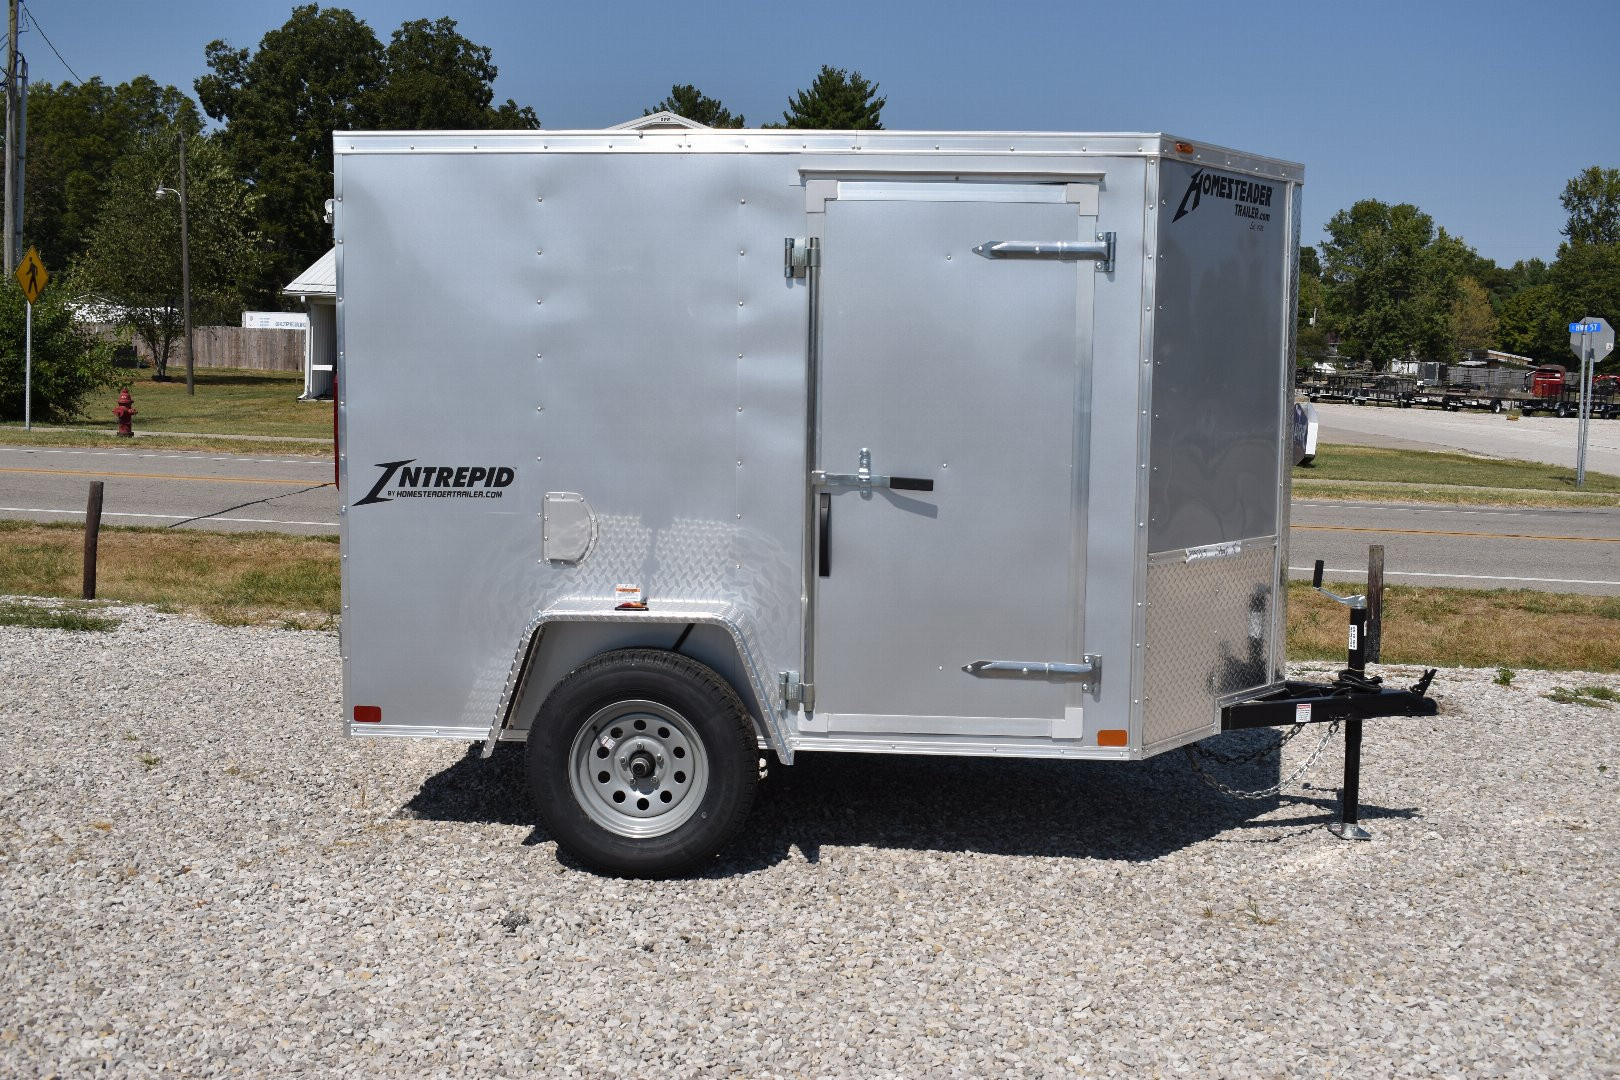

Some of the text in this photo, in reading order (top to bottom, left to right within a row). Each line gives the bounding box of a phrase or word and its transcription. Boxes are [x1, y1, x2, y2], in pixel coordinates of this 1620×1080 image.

[1172, 168, 1272, 223] HOMESTEADER
[1590, 323, 1598, 331] 57
[352, 458, 515, 506] INTREPID
[396, 490, 503, 499] HOMESTEADERTRAILER.COM
